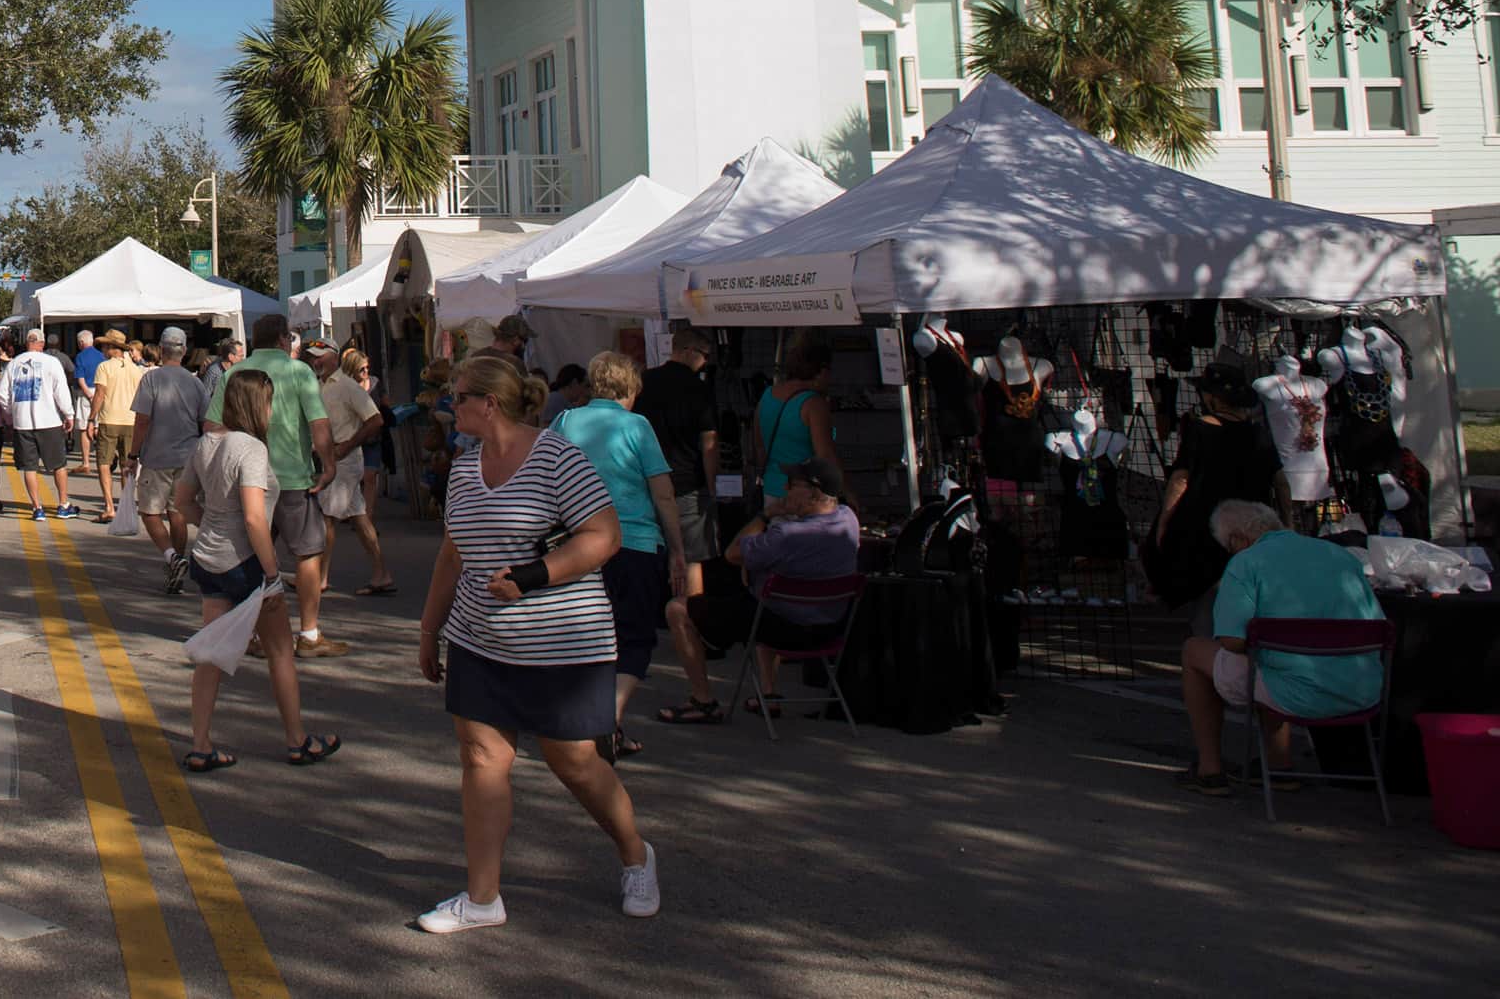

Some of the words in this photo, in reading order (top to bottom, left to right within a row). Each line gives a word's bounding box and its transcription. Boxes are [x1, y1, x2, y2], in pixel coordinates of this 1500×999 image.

[707, 278, 728, 291] TWICE
[729, 278, 736, 289] IS
[737, 276, 755, 289] NICE
[759, 273, 800, 288] WEARABLE
[801, 272, 817, 285] ART
[792, 298, 829, 311] MATERIALS
